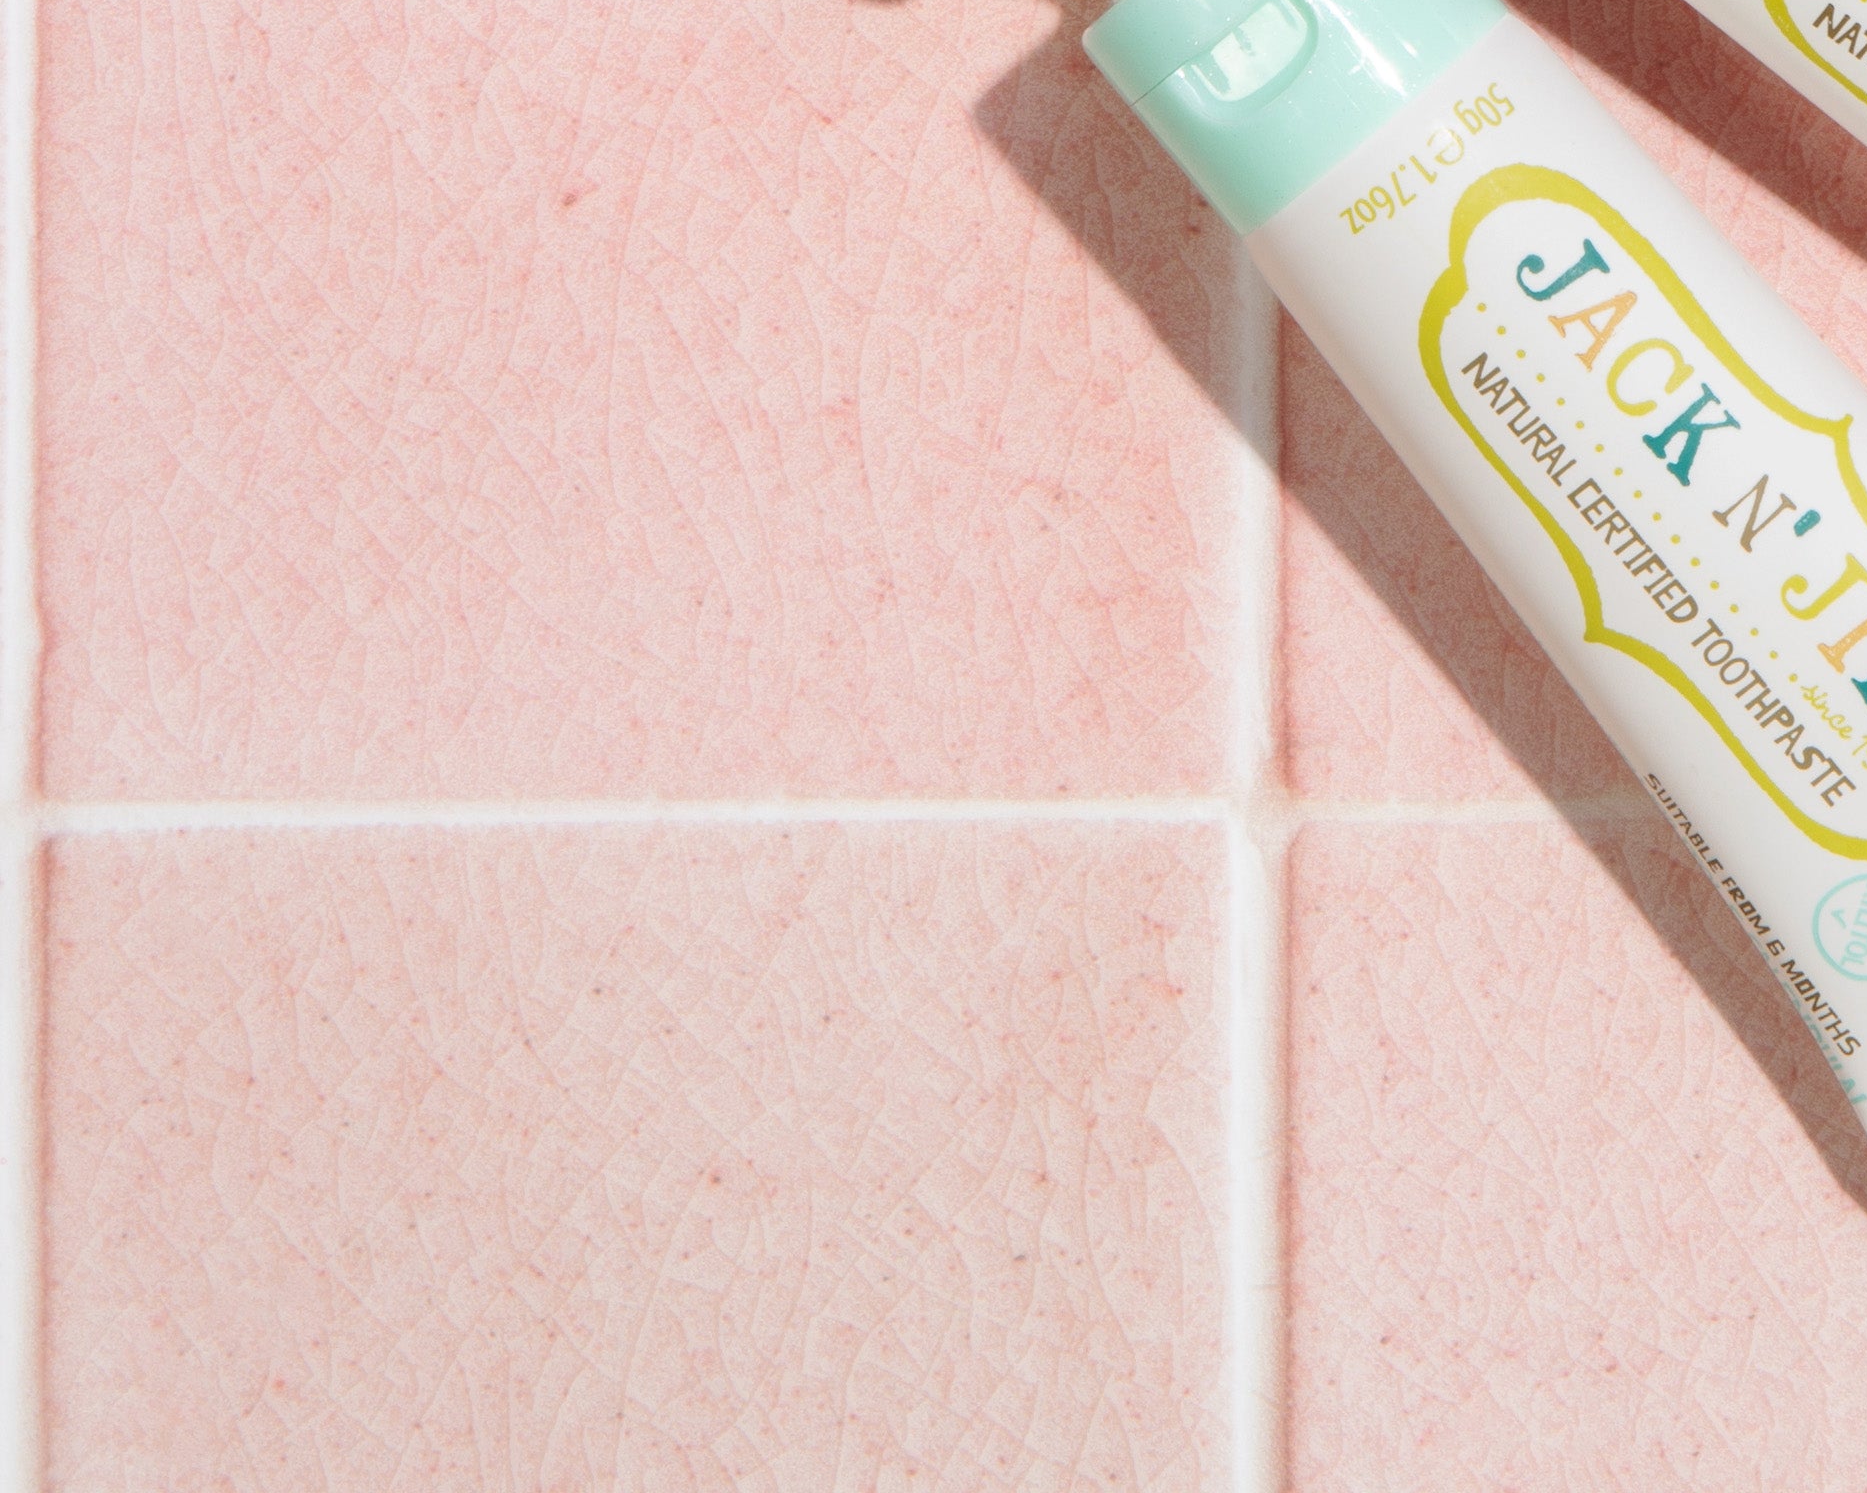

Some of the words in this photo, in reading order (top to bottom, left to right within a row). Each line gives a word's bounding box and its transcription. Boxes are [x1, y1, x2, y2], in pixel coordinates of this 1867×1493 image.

[1338, 156, 1437, 236] 1.76oz
[1453, 82, 1515, 135] 50g
[1516, 238, 1741, 487] JACK
[1712, 474, 1821, 553] N'
[1461, 352, 1577, 487] NATURAL
[1567, 478, 1699, 624] CERTIFIED
[1691, 618, 1856, 807] TOOTHPASTE
[1800, 685, 1853, 741] since
[1641, 770, 1725, 873] SUITABLE
[1719, 874, 1772, 937] FROM
[1764, 935, 1788, 959] 6
[1778, 956, 1863, 1058] MONTHS
